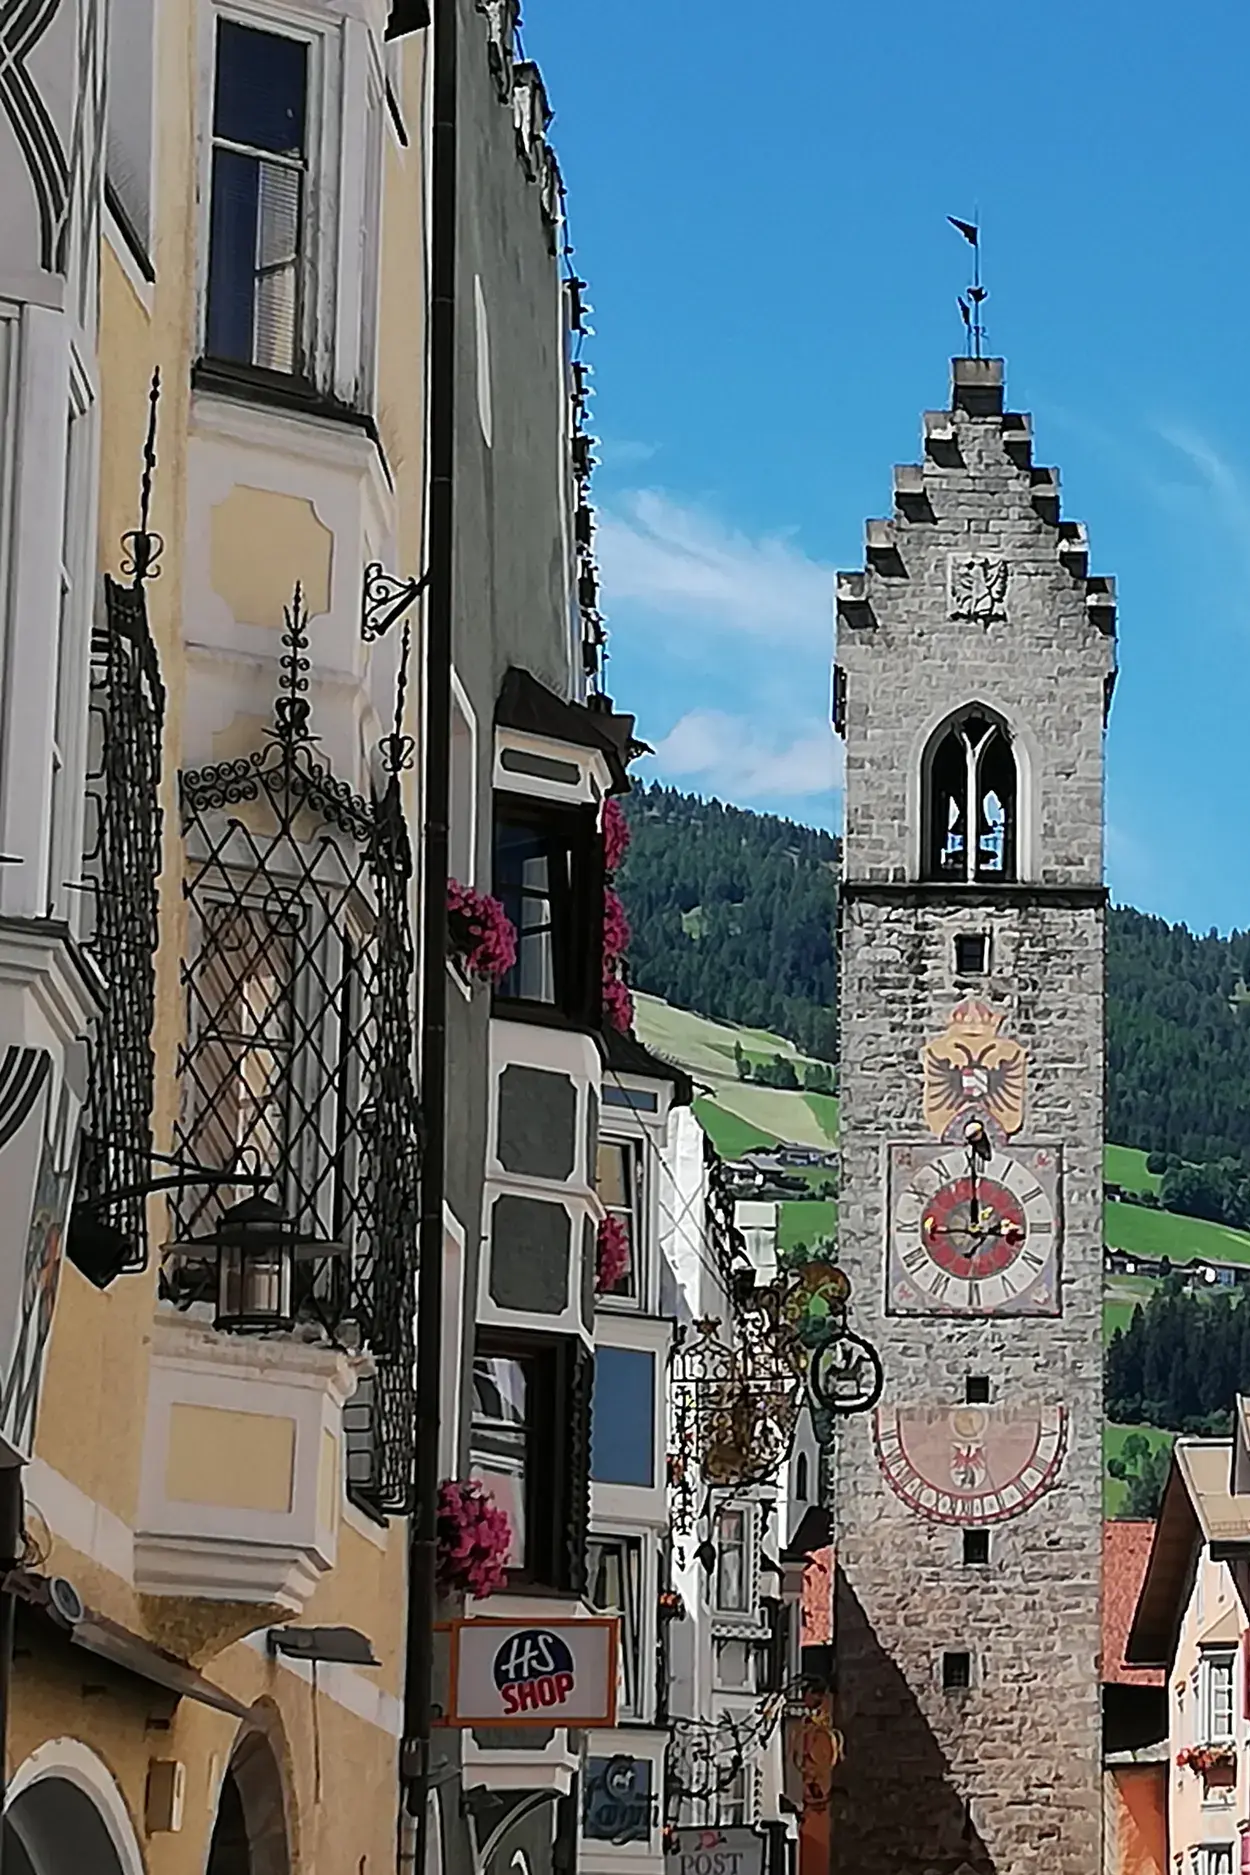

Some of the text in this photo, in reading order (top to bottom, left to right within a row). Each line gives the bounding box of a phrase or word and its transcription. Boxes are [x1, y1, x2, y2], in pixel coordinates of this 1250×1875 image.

[500, 1634, 556, 1679] HS
[501, 1672, 575, 1715] SHOP
[680, 1852, 744, 1875] POST
